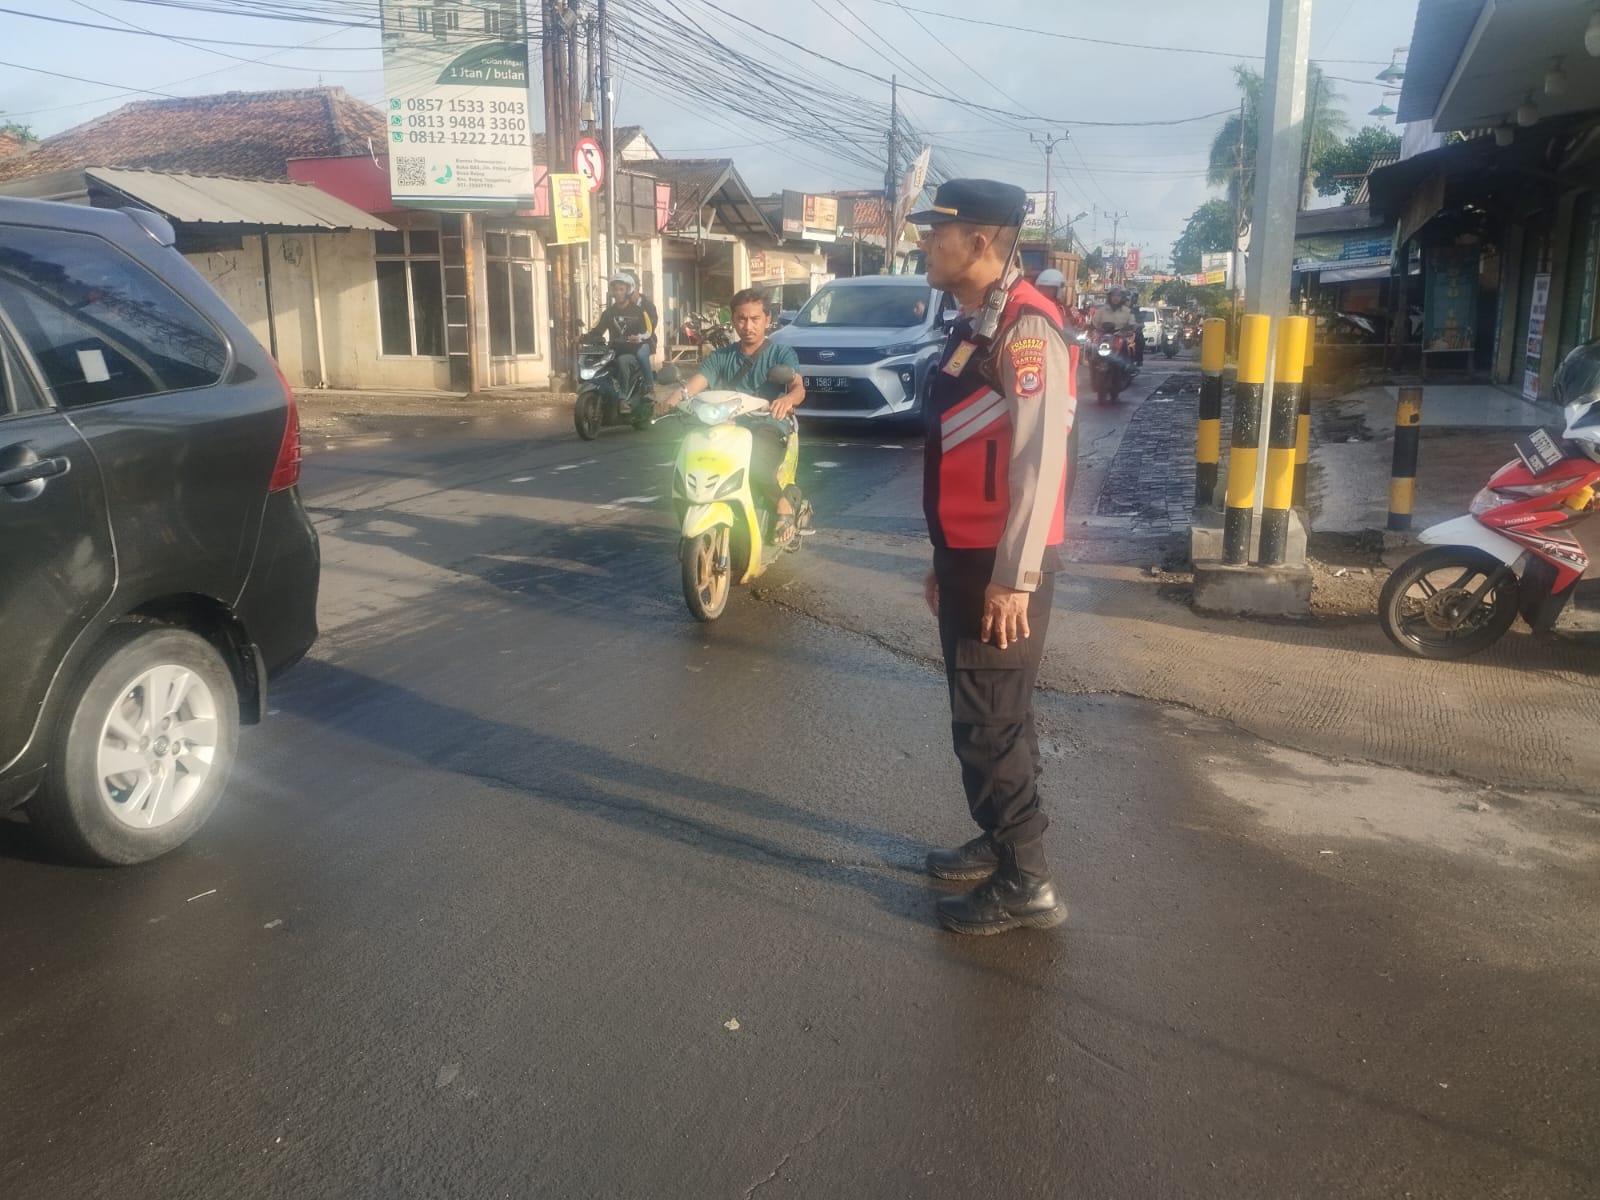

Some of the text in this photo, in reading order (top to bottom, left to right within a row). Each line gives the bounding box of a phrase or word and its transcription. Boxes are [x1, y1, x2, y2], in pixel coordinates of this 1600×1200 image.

[450, 67, 458, 77] 1
[494, 68, 525, 81] bulan
[407, 98, 525, 115] 0857 1533 3043
[408, 114, 526, 131] 0813 9484 3360
[409, 130, 526, 146] 0812 1222 2412
[1504, 515, 1537, 525] HONDA
